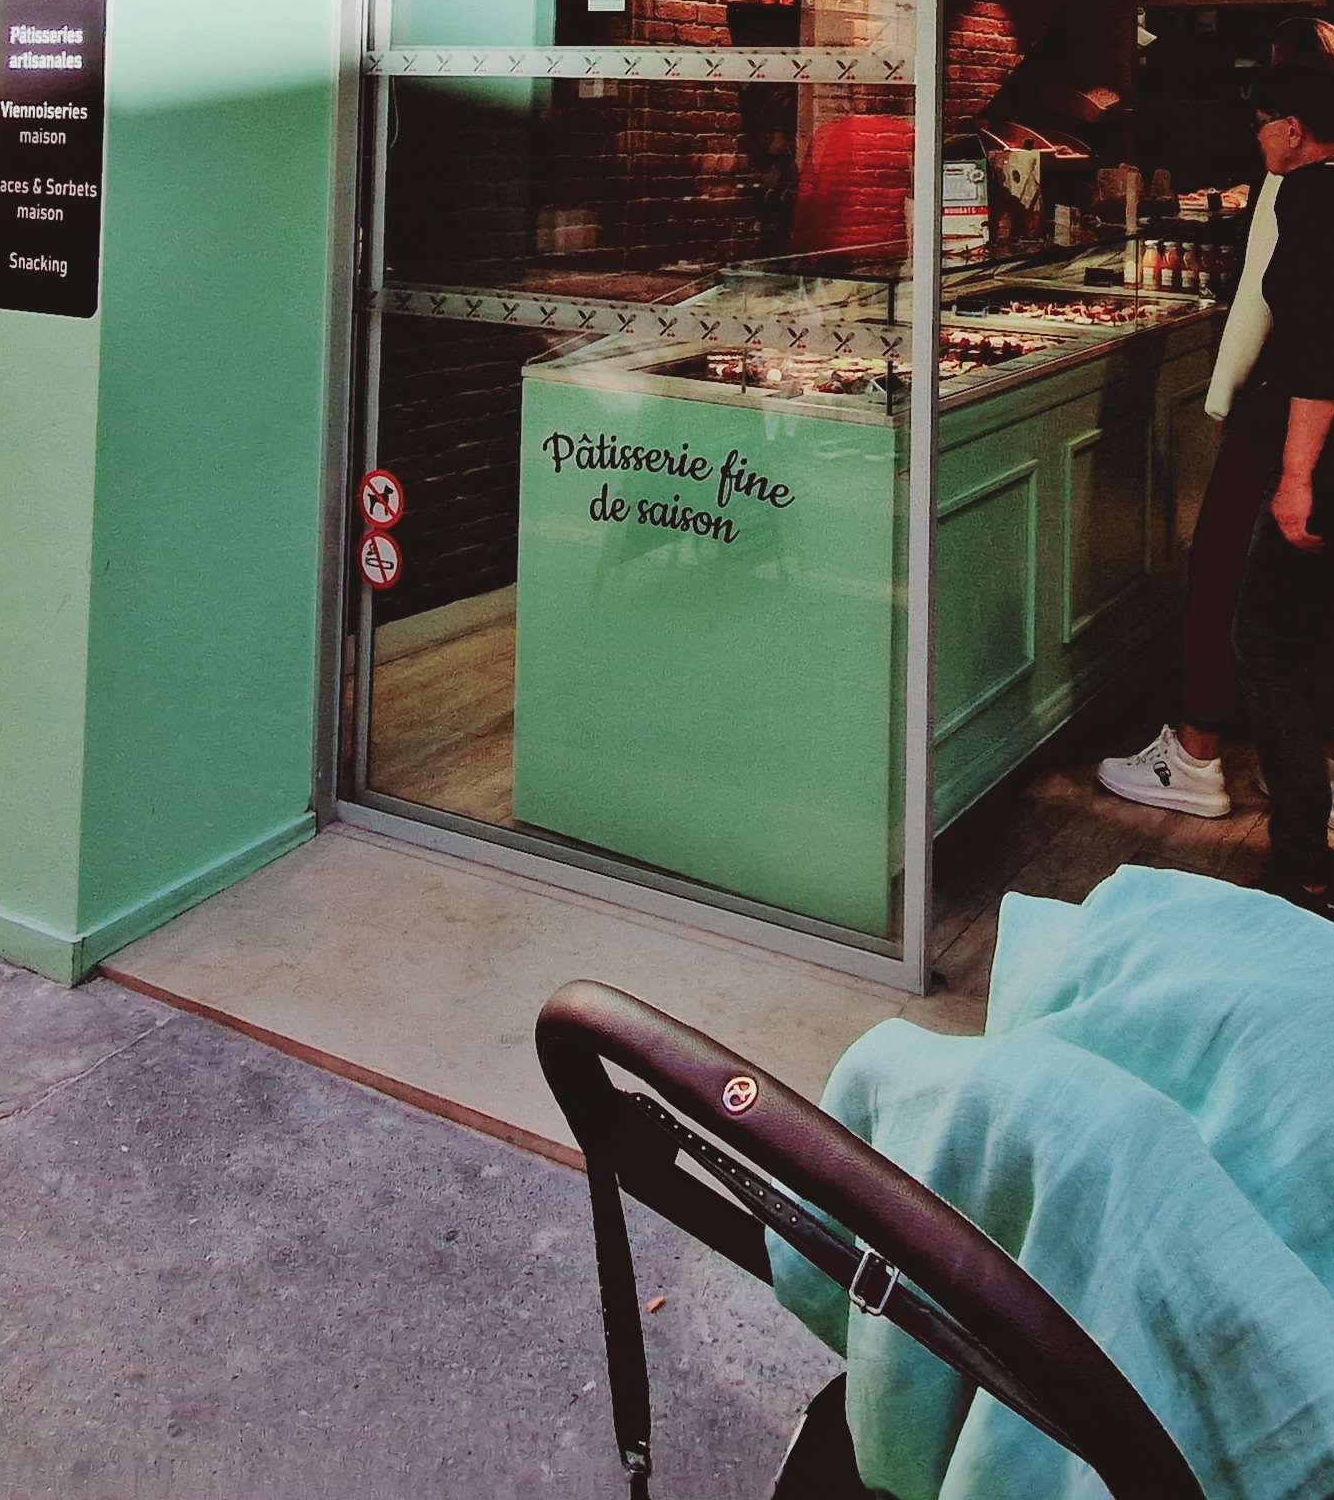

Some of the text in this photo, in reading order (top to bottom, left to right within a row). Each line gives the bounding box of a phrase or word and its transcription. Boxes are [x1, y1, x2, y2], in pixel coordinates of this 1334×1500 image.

[9, 25, 83, 44] Pâtisseries
[8, 51, 83, 69] artisanales
[0, 101, 88, 120] Viennoiseries
[19, 128, 66, 144] maison
[33, 178, 42, 194] &
[46, 179, 97, 198] Sorbets
[17, 204, 63, 221] maison
[9, 252, 68, 277] Snacking
[542, 431, 795, 508] Pâtisserie fine
[589, 484, 741, 544] de saison
